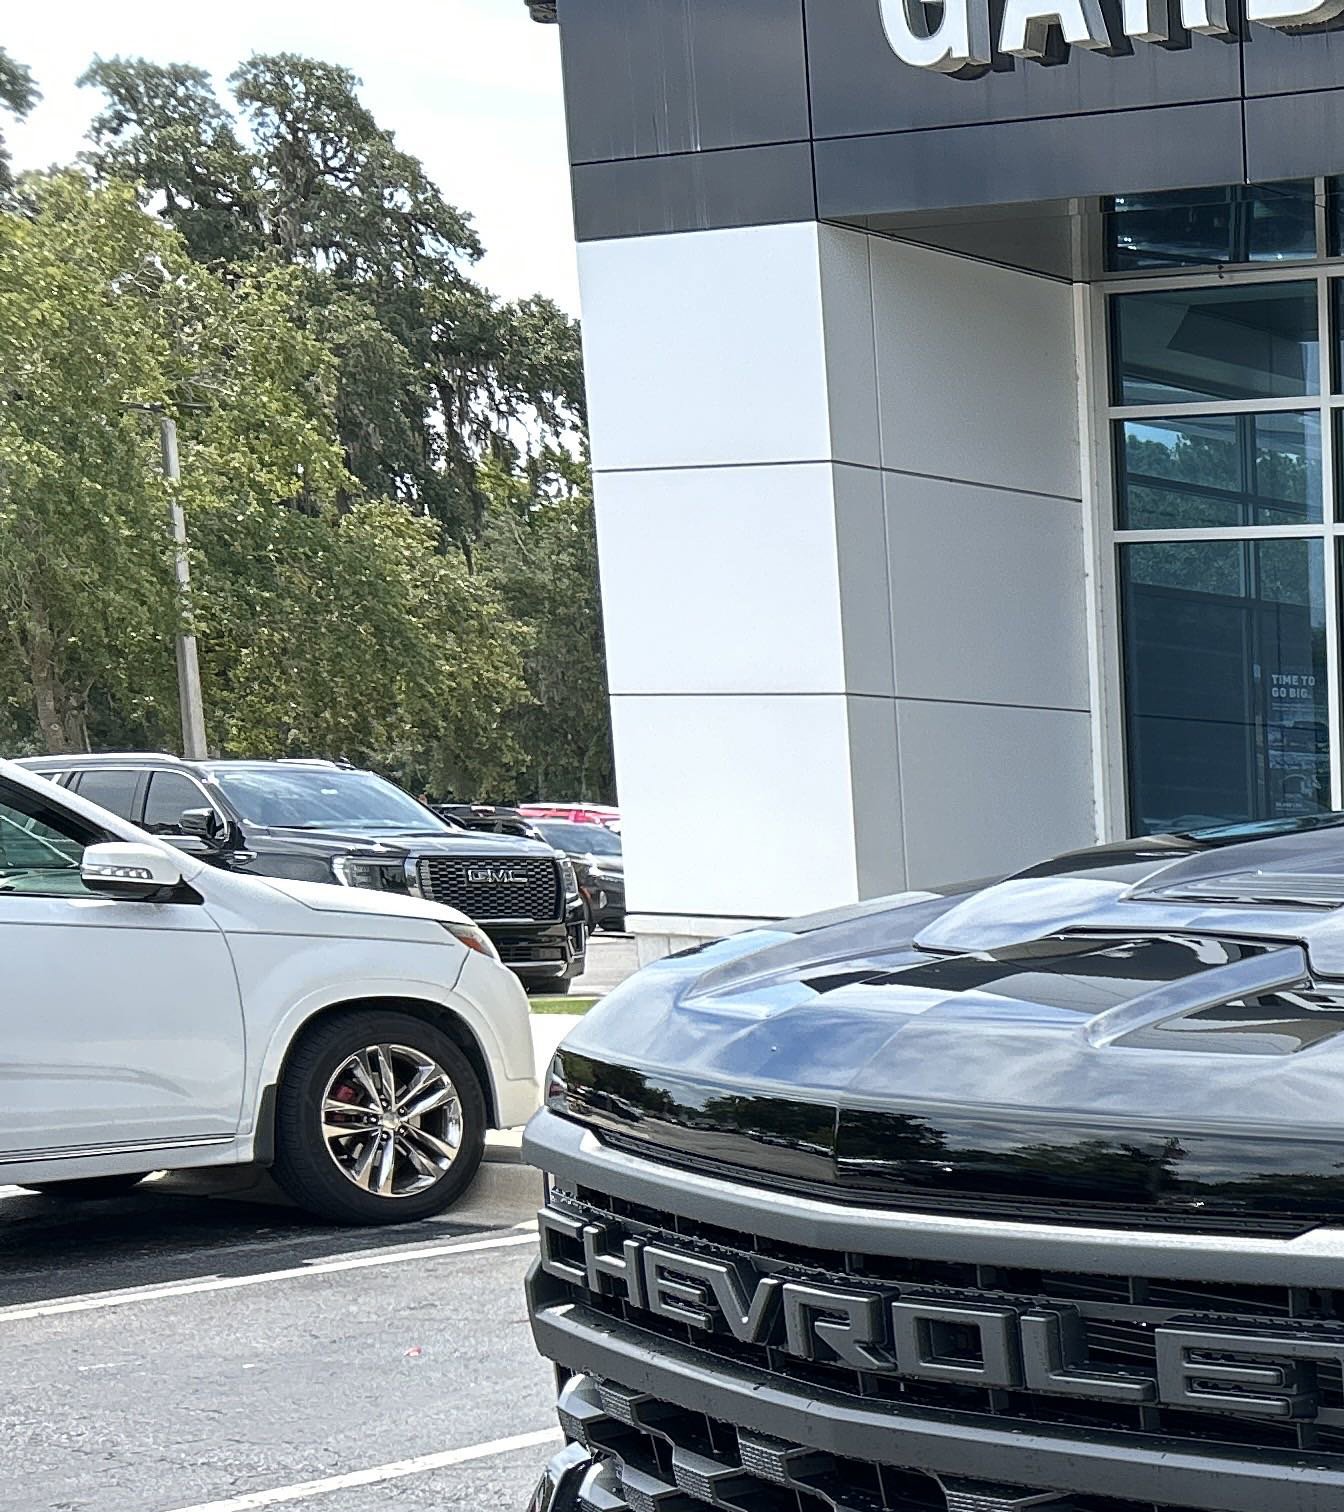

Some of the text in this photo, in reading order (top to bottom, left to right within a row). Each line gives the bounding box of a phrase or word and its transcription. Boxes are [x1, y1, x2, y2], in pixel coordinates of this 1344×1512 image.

[1271, 674, 1316, 687] TIME TO
[1271, 687, 1287, 698] GO
[467, 868, 529, 884] GMC
